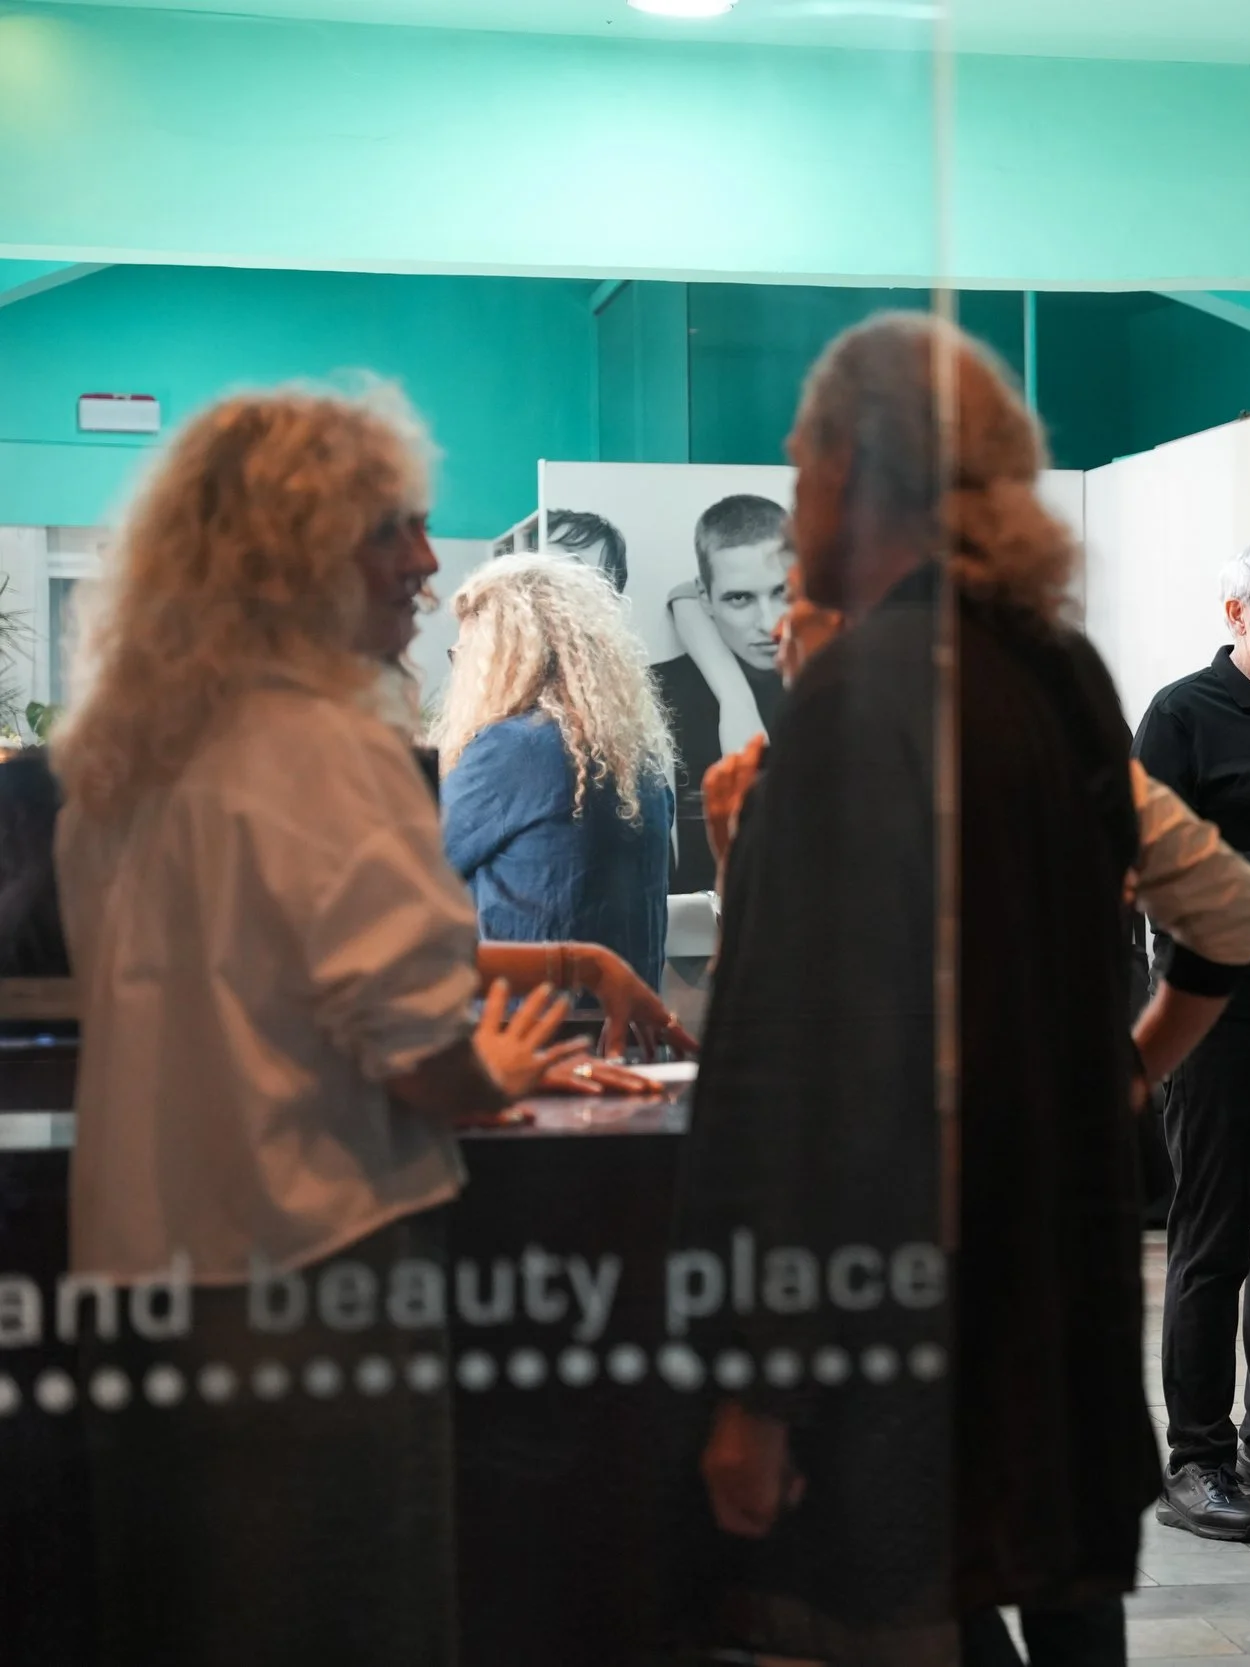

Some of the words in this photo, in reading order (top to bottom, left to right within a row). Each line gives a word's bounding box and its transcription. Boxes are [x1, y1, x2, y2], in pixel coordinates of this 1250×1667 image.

[0, 1249, 192, 1347] and
[248, 1243, 621, 1341] beauty
[666, 1228, 947, 1335] place
